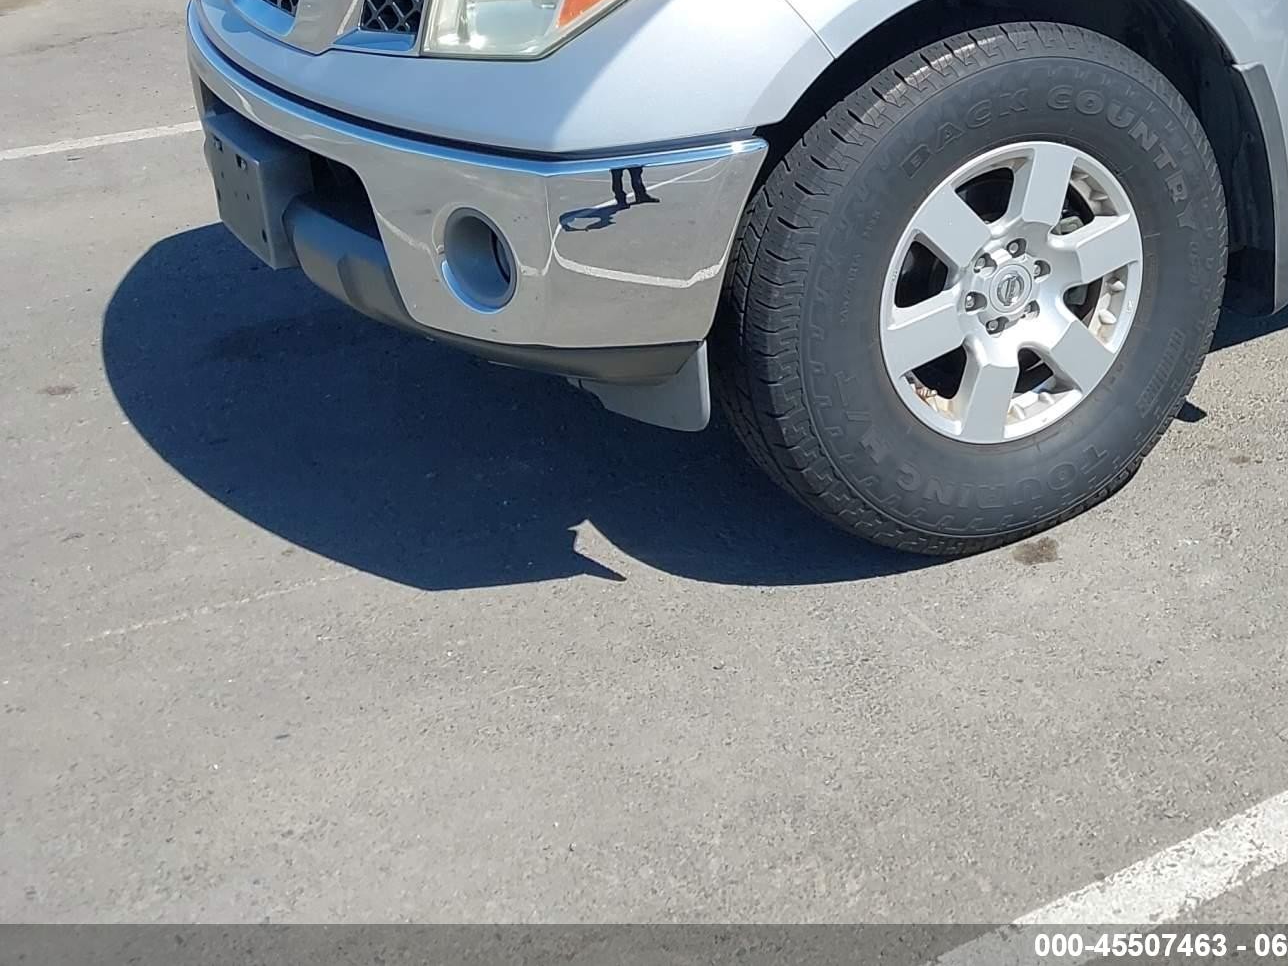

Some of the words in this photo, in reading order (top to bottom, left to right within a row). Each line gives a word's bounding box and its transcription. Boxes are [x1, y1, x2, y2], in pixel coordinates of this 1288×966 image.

[901, 87, 1029, 179] BACK
[1046, 85, 1194, 230] COUNTRY
[897, 444, 1108, 509] TOURING
